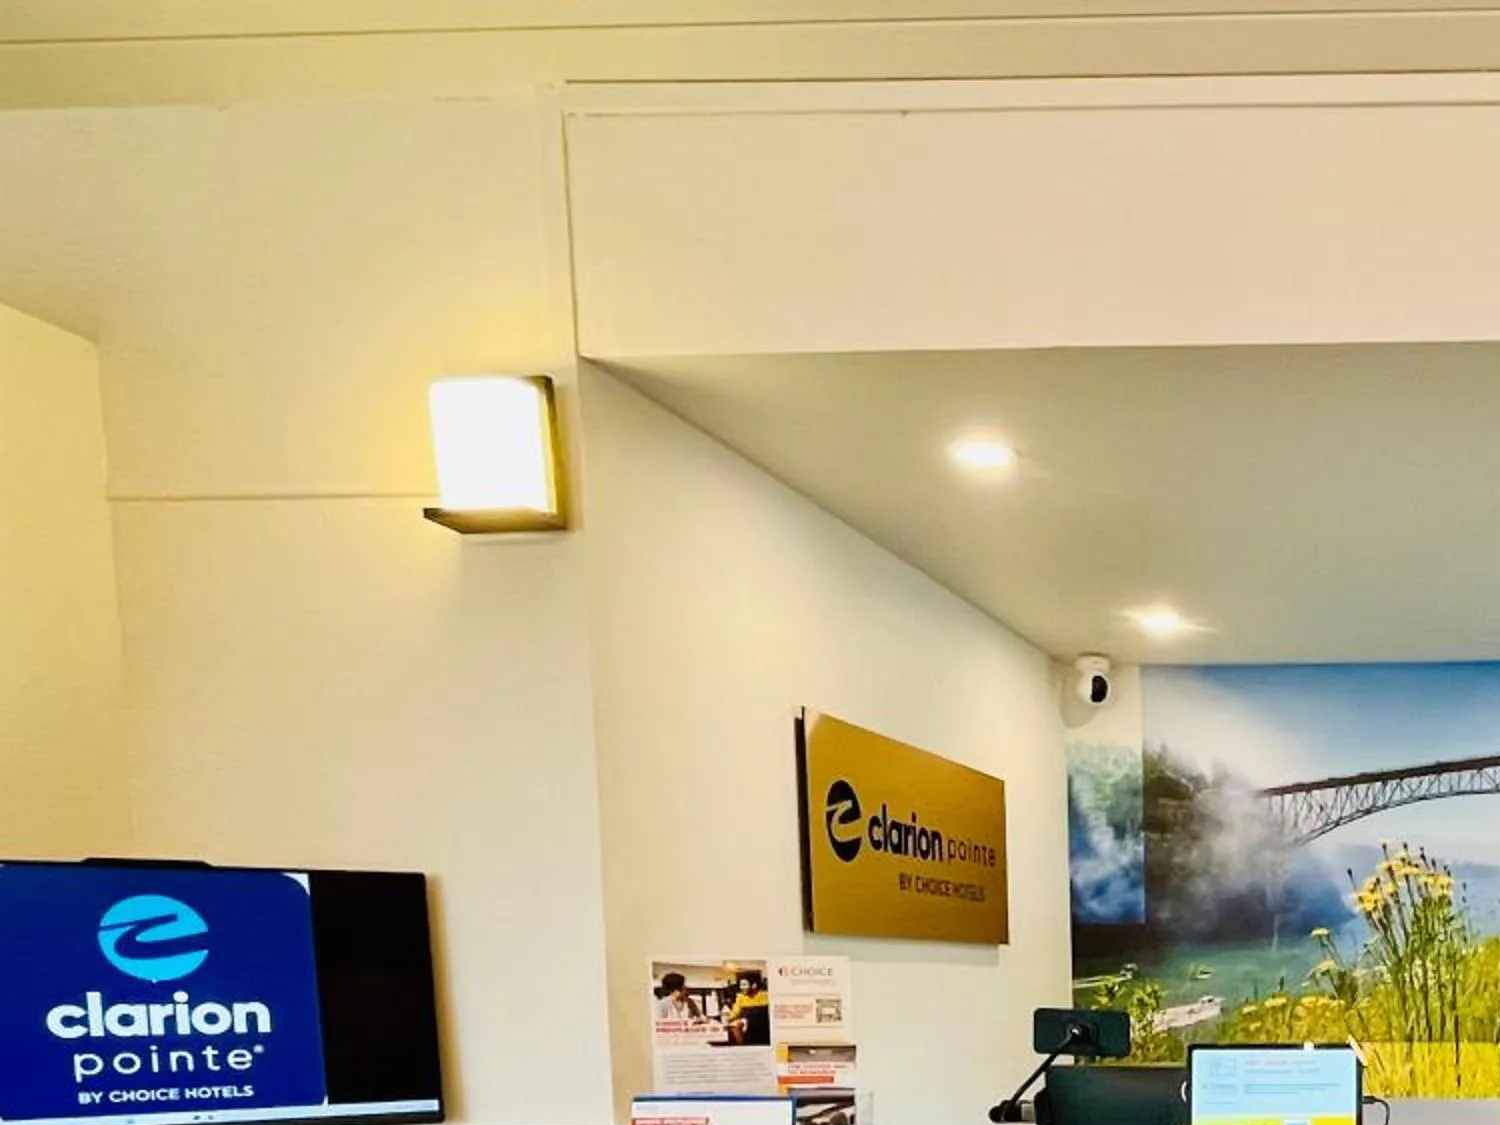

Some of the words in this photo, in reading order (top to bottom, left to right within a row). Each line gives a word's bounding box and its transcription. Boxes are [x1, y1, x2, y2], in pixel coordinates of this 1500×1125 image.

[868, 803, 943, 862] clarion
[947, 838, 997, 868] pointe
[899, 873, 912, 890] BY
[916, 876, 951, 896] CHOICE
[46, 991, 272, 1039] clarion
[78, 1092, 103, 1104] BY
[109, 1088, 180, 1103] CHOICE
[185, 1086, 254, 1099] HOTELS
